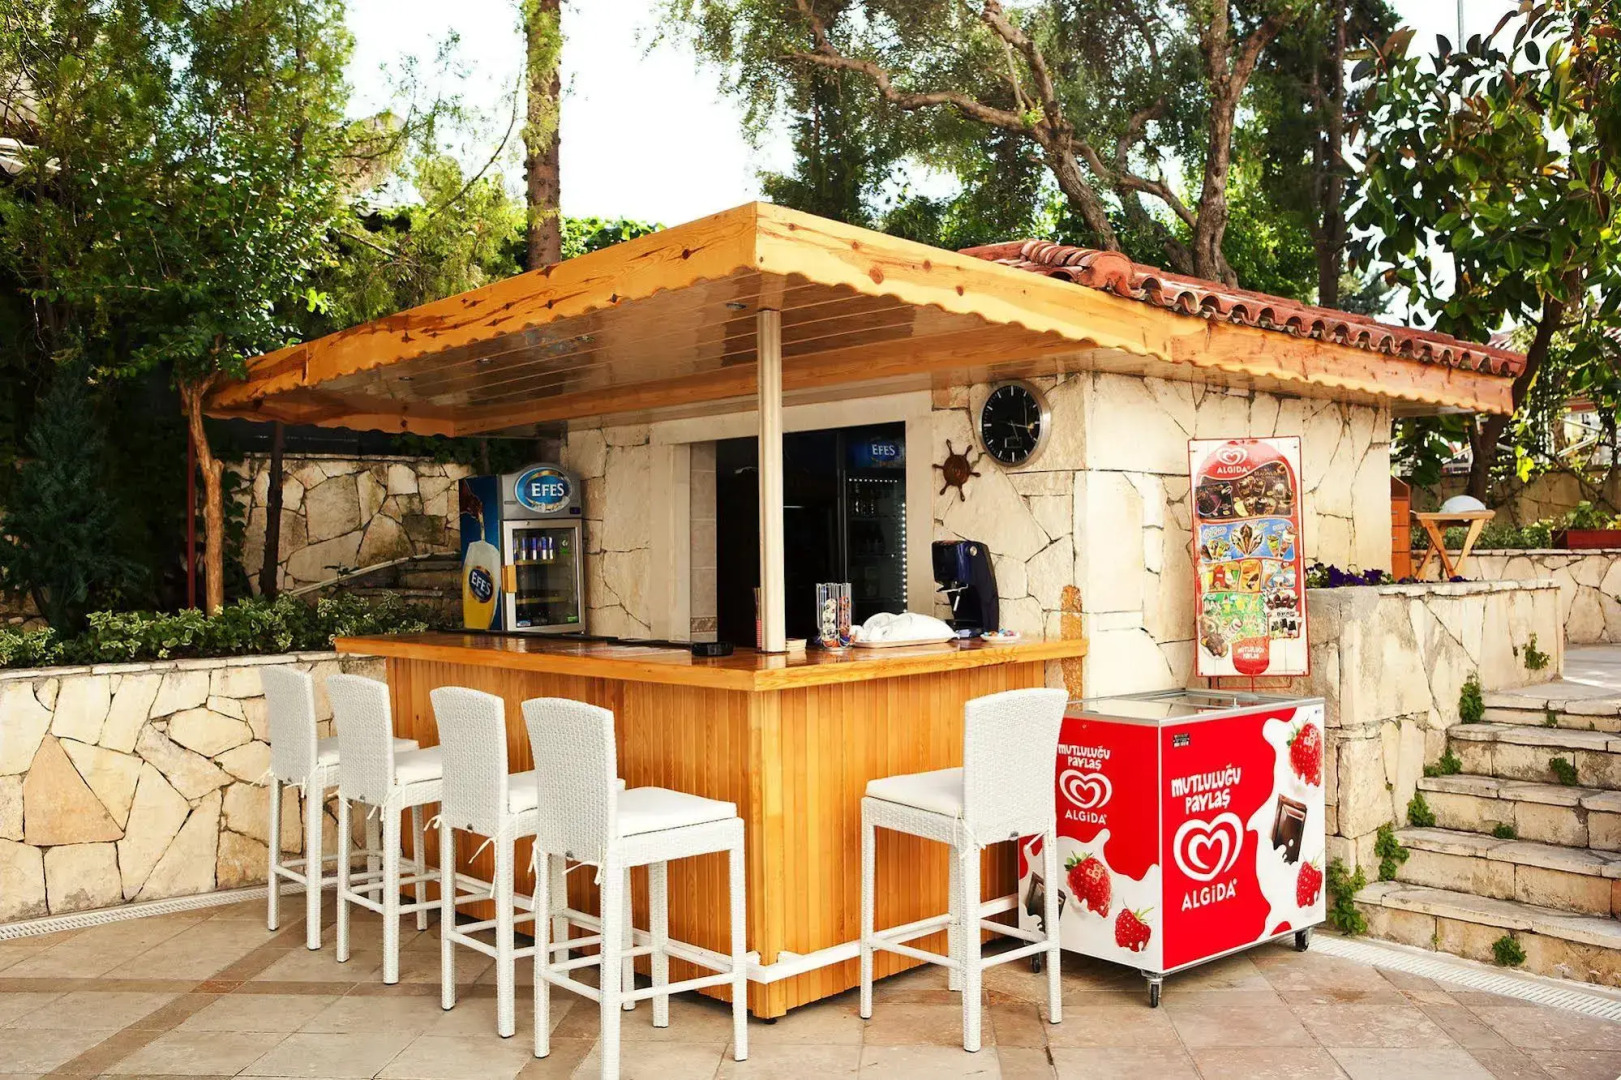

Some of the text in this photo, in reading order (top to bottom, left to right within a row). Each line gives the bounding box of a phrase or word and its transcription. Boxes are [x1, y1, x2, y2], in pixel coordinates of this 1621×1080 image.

[872, 444, 896, 456] EFES
[1217, 465, 1249, 475] ALGIDA
[531, 483, 565, 497] EFES
[470, 573, 492, 596] EFES
[1171, 763, 1242, 798] MUTLULUĞU
